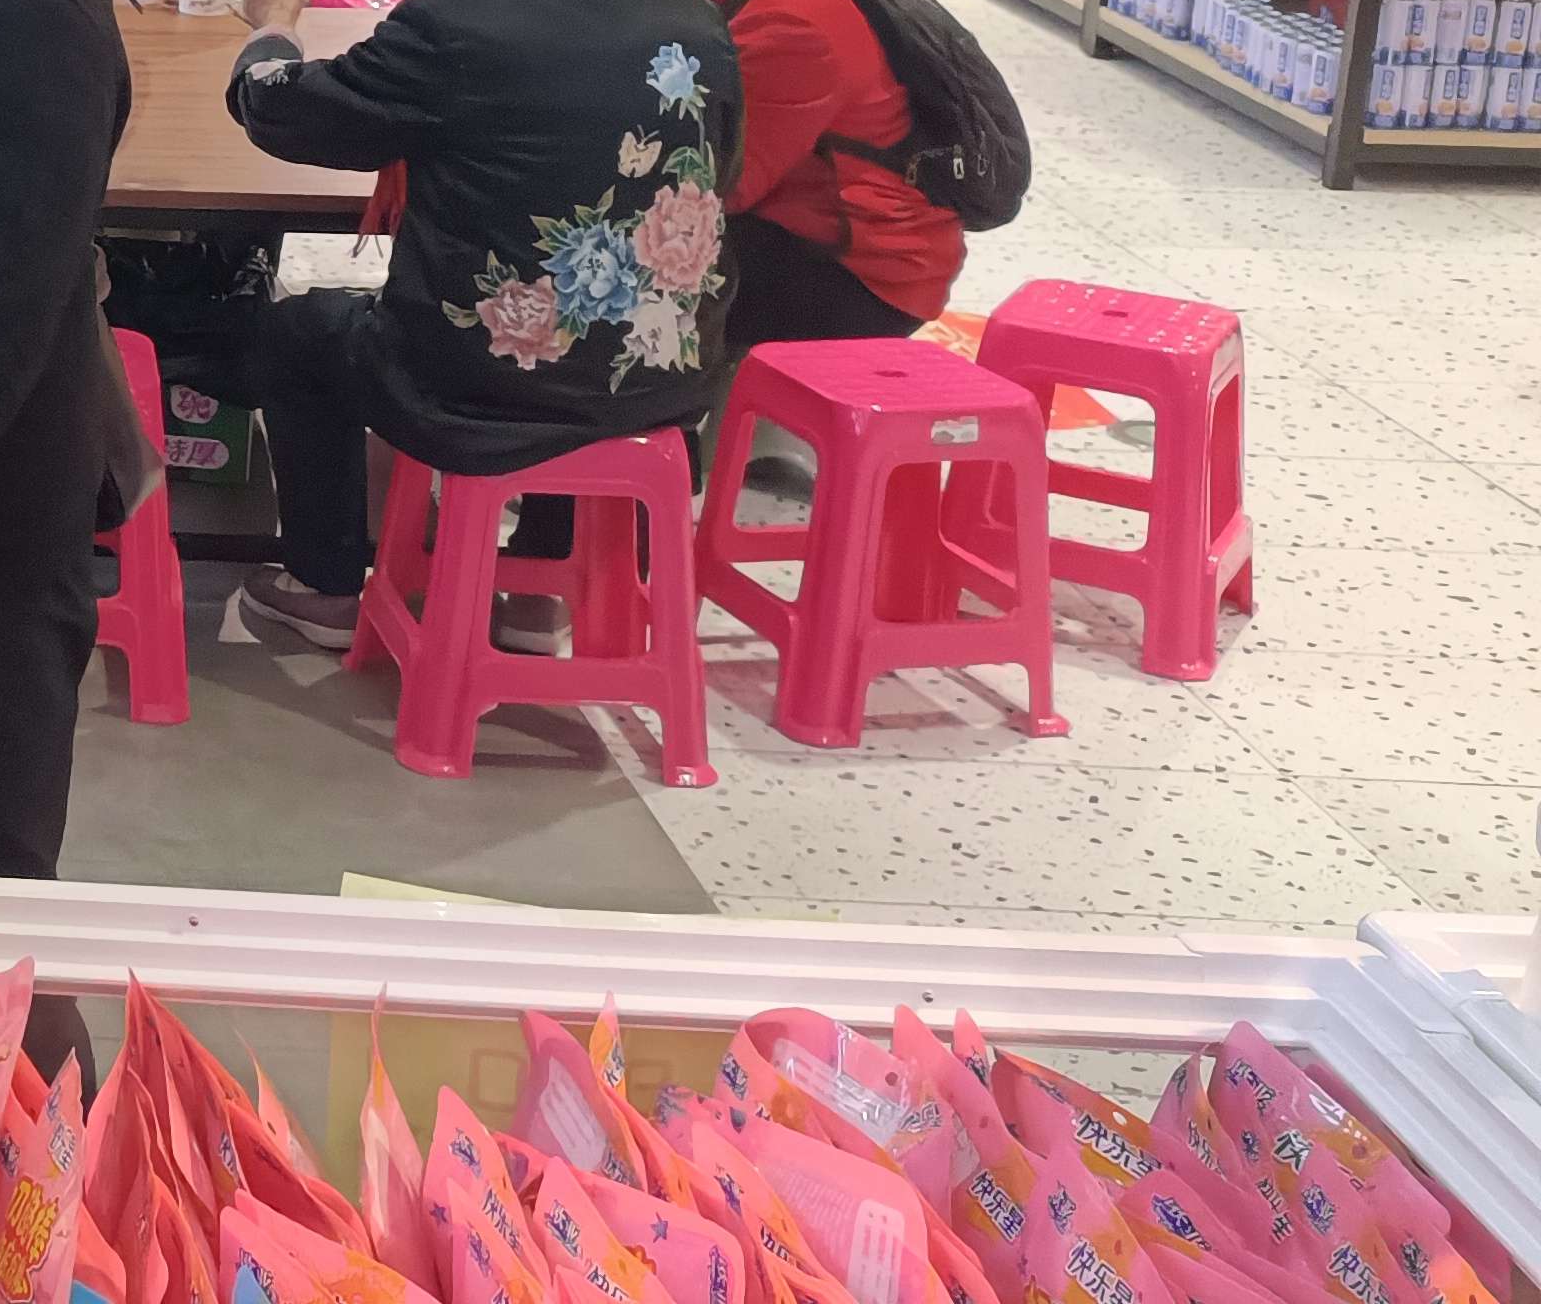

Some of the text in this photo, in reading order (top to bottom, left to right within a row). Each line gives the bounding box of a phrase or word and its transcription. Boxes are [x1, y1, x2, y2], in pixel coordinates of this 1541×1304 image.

[1075, 1112, 1162, 1180] 快乐星
[970, 1170, 1024, 1243] 快乐星
